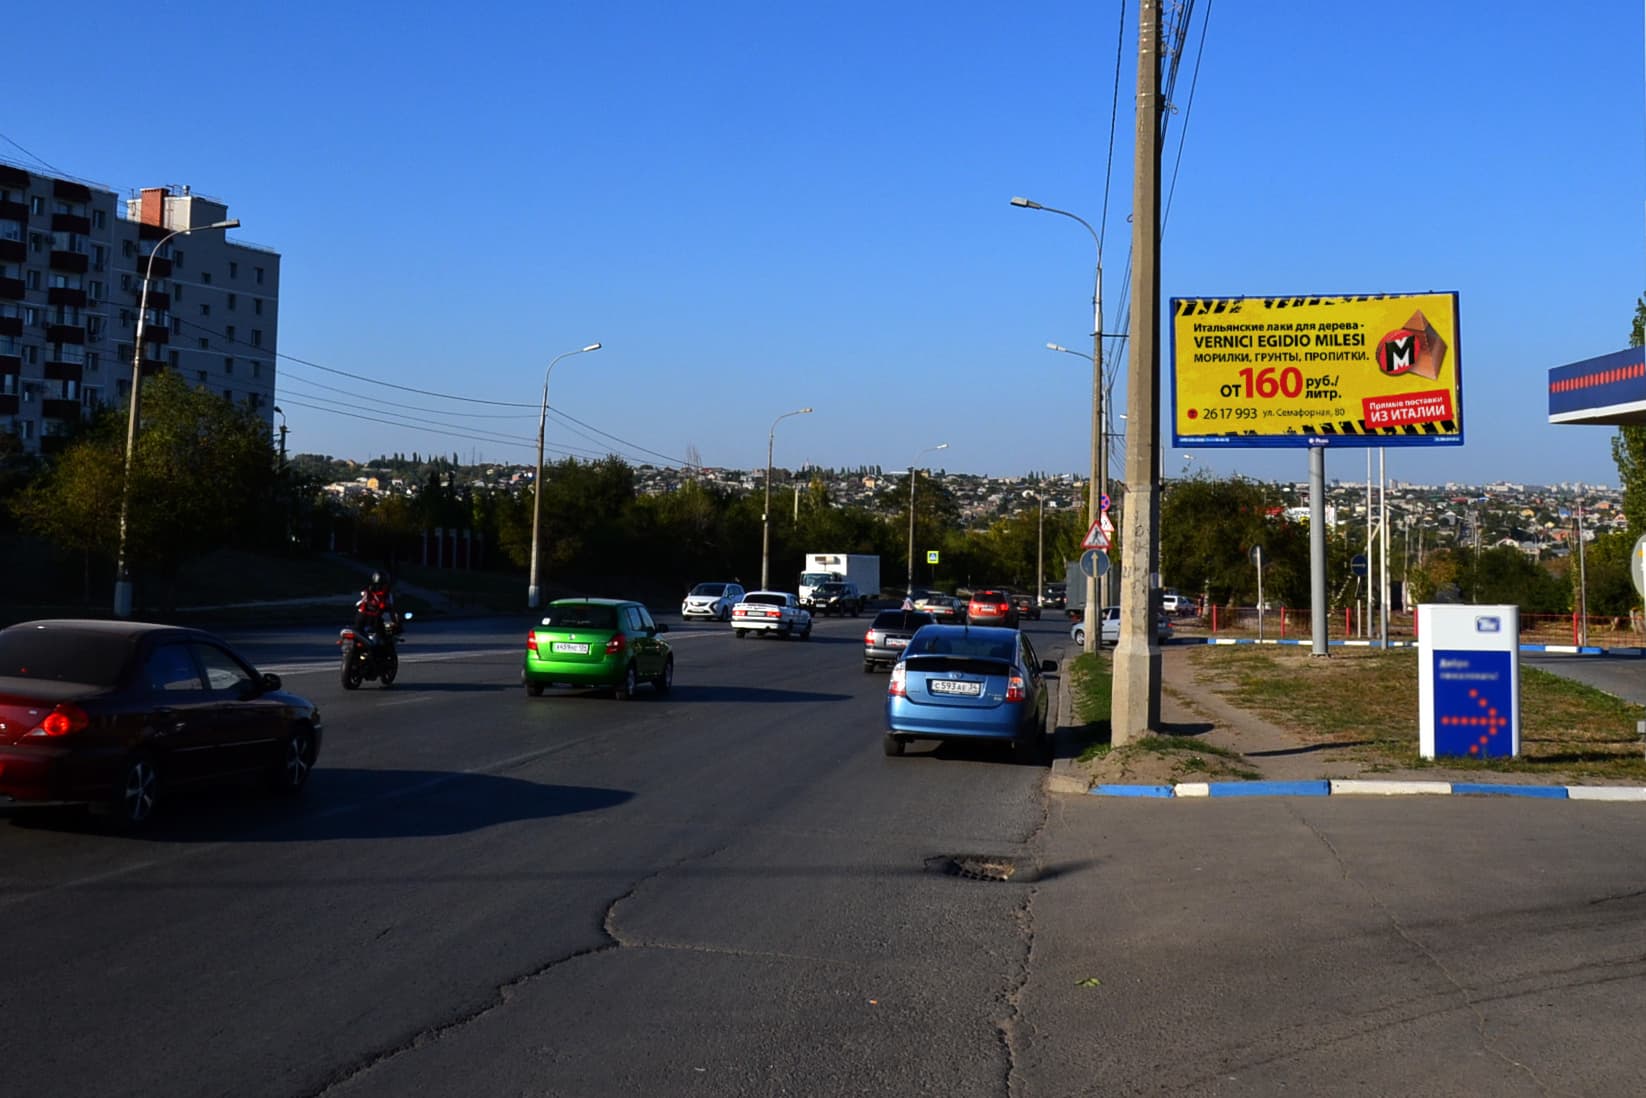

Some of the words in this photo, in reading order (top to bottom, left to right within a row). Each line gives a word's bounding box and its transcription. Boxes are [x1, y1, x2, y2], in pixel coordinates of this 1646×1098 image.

[1193, 323, 1265, 333] Итальянские
[1266, 323, 1293, 332] лаки
[1295, 323, 1316, 332] для
[1318, 322, 1359, 332] дерева
[1193, 335, 1253, 349] VERNICI
[1257, 334, 1311, 348] EGIDIO
[1315, 333, 1365, 347] MILESI
[1193, 353, 1252, 363] МОРИЛКИ,
[1255, 352, 1301, 362] ГРУНТЫ,
[1304, 351, 1369, 361] ПРОПИТКИ.
[1238, 366, 1304, 399] 160
[1304, 389, 1342, 401] литр.
[1234, 407, 1258, 420] 993
[1371, 410, 1389, 423] ИЗ
[1390, 404, 1446, 420] ИТАЛИИ
